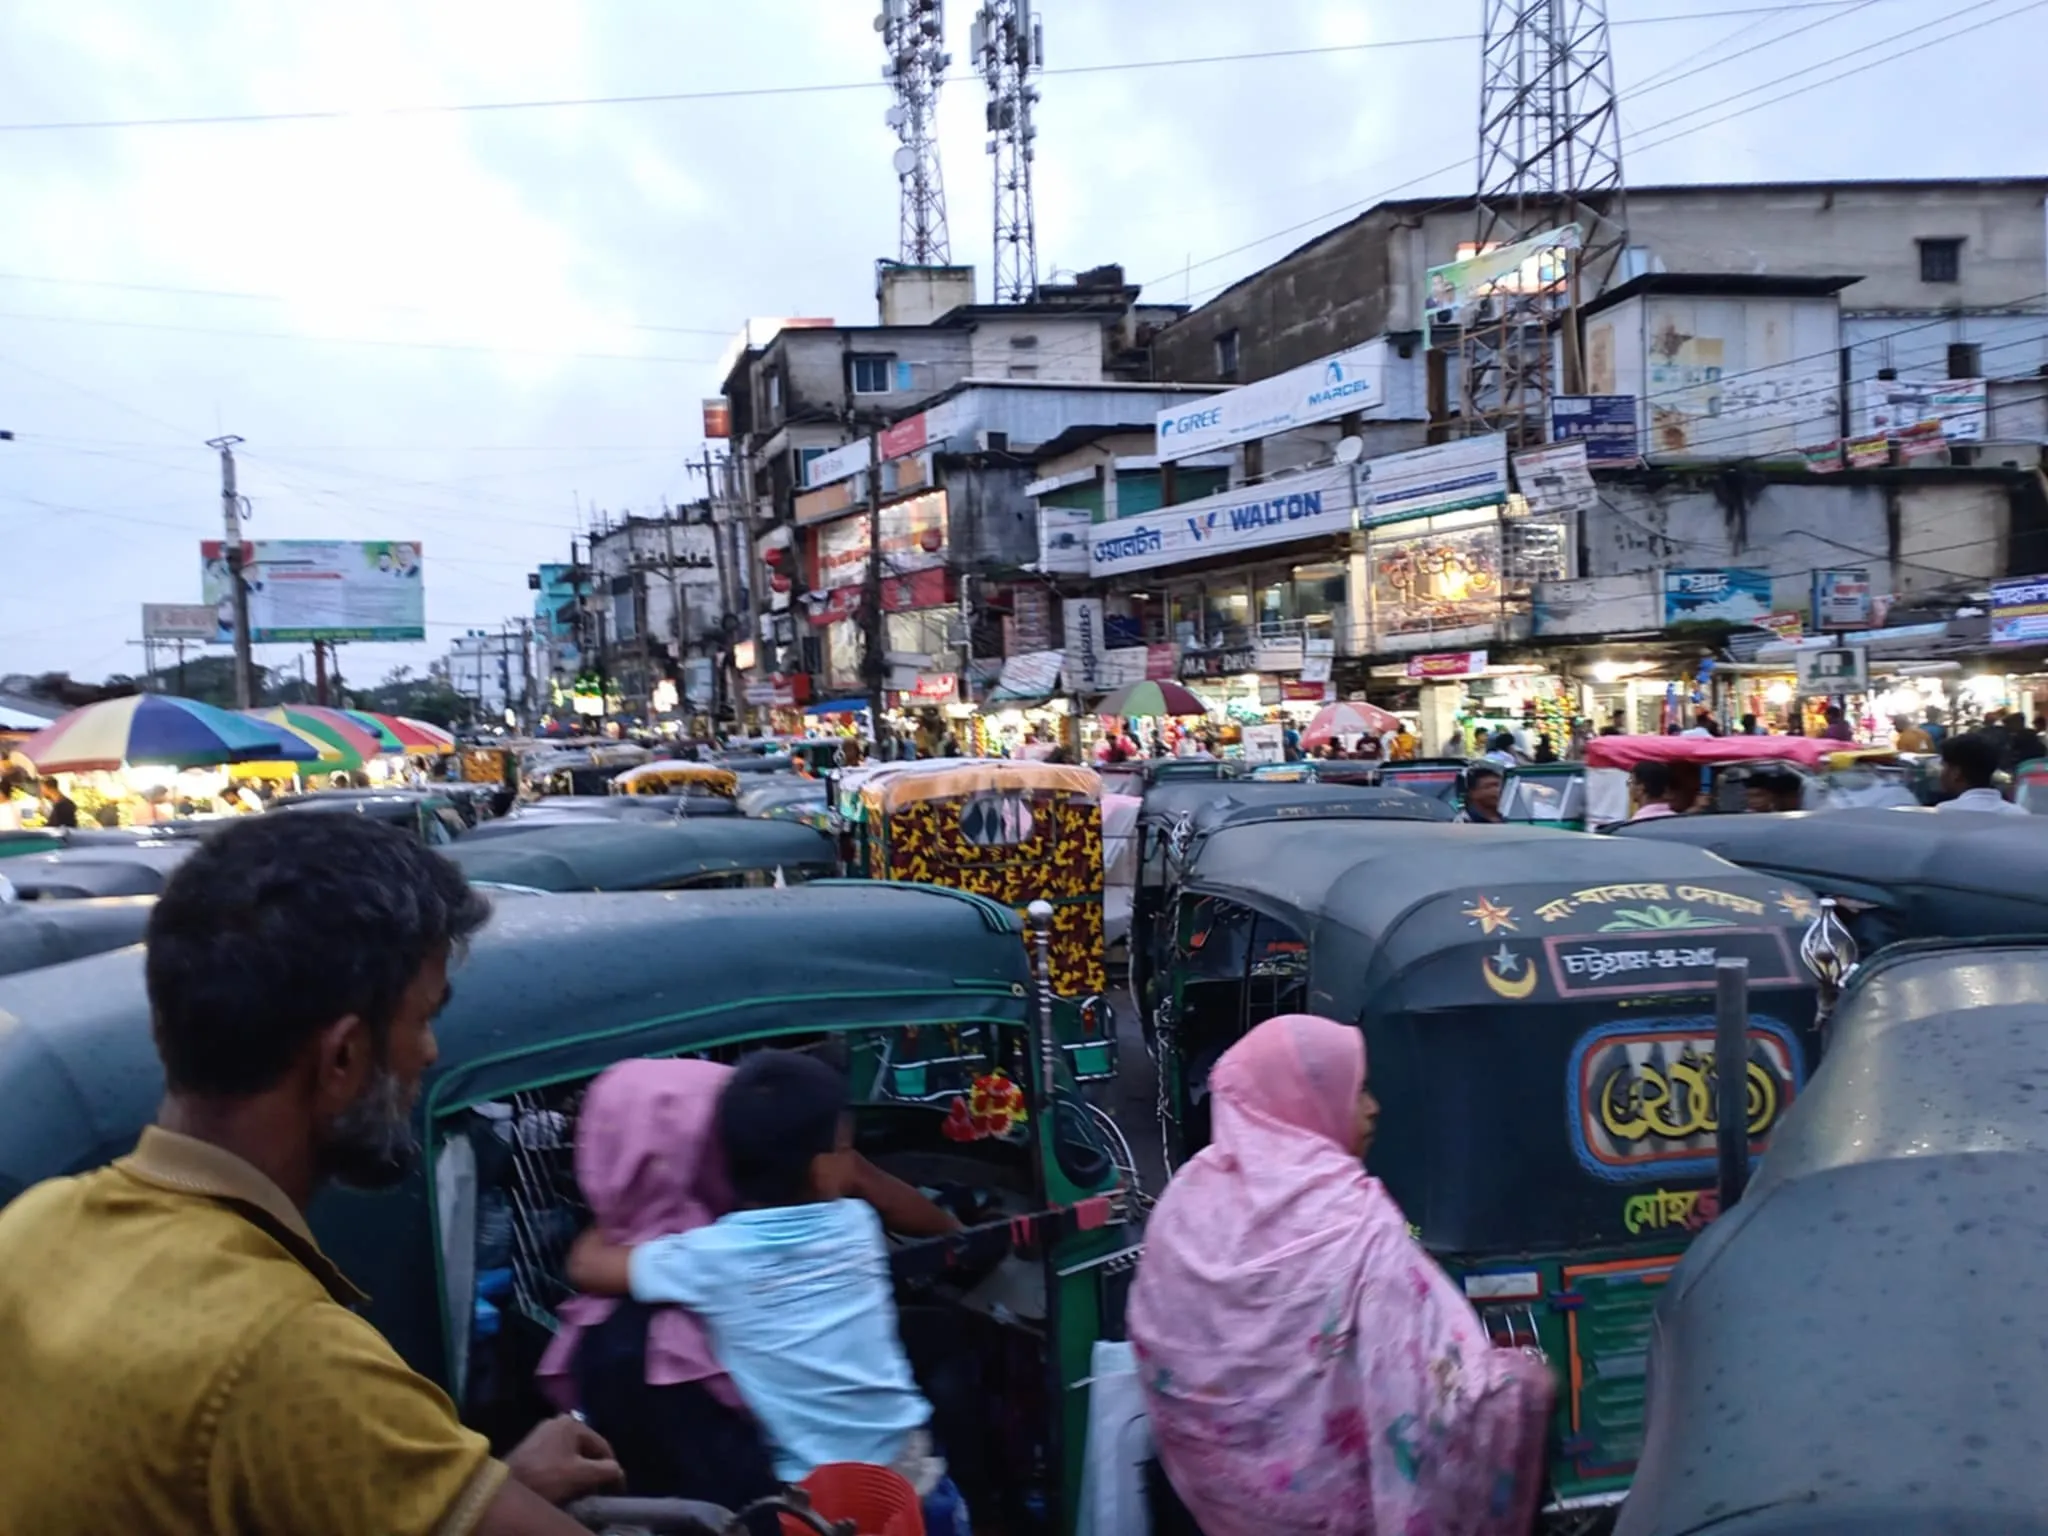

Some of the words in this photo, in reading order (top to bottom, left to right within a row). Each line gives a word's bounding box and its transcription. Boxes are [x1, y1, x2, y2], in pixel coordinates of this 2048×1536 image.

[1308, 380, 1369, 406] MARCEL
[1177, 407, 1222, 433] GREE
[1230, 489, 1322, 532] WALTON
